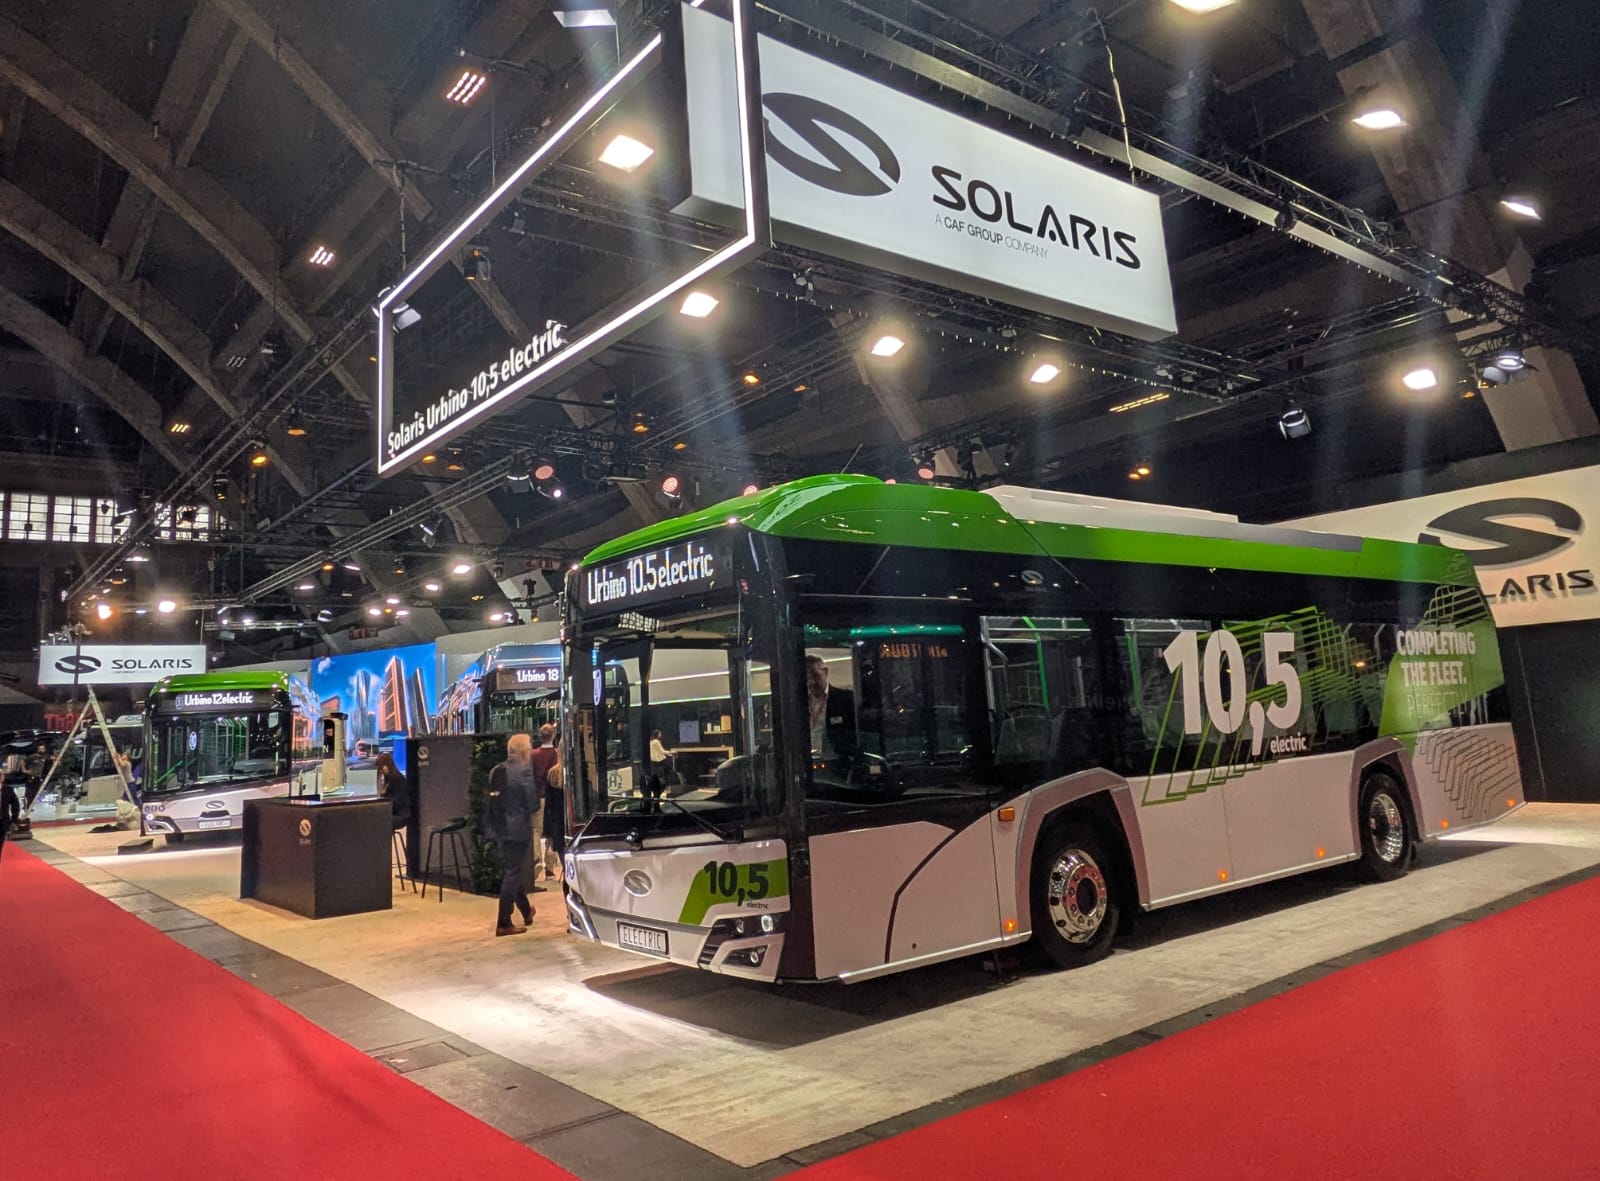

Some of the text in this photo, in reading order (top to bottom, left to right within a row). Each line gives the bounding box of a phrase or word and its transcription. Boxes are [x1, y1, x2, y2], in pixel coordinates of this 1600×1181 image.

[932, 165, 1140, 270] SOLARIS
[934, 214, 1049, 260] A CAF GROUP COMPANY
[387, 319, 567, 455] Solaris Urbino 10,5 electric
[587, 566, 626, 605] Urbino
[1485, 569, 1594, 600] ARIS
[1396, 630, 1476, 655] COMPLETING
[111, 658, 193, 670] SOLARIS
[516, 668, 560, 683] Urbino 18
[1401, 661, 1468, 688] THE FLEET.
[1163, 629, 1302, 756] 10,5
[1270, 731, 1307, 755] electric
[703, 860, 769, 907] 10,5
[623, 926, 663, 950] ELECTRIC
